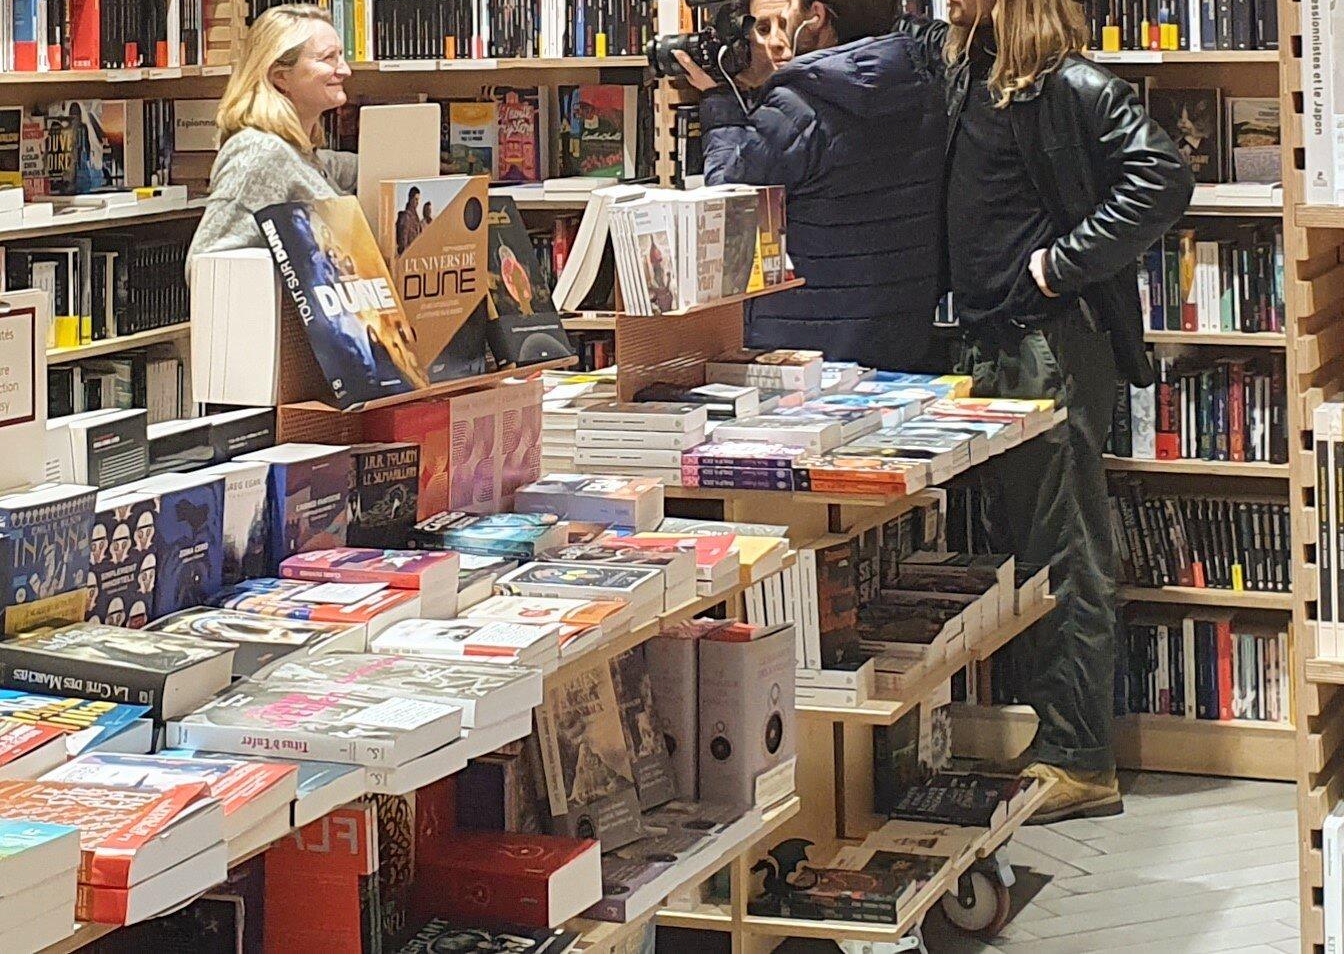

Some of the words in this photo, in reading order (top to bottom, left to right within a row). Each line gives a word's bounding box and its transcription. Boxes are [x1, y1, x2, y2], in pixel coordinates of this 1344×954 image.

[1312, 73, 1323, 84] et
[1313, 87, 1323, 98] le
[1312, 101, 1324, 136] Japon
[261, 218, 288, 260] DUNE
[279, 261, 300, 294] SUR
[404, 252, 461, 273] L'UNIVERS
[461, 251, 476, 266] DE
[313, 277, 397, 318] DUNE
[403, 268, 476, 301] DUNE
[293, 290, 314, 327] TOUT
